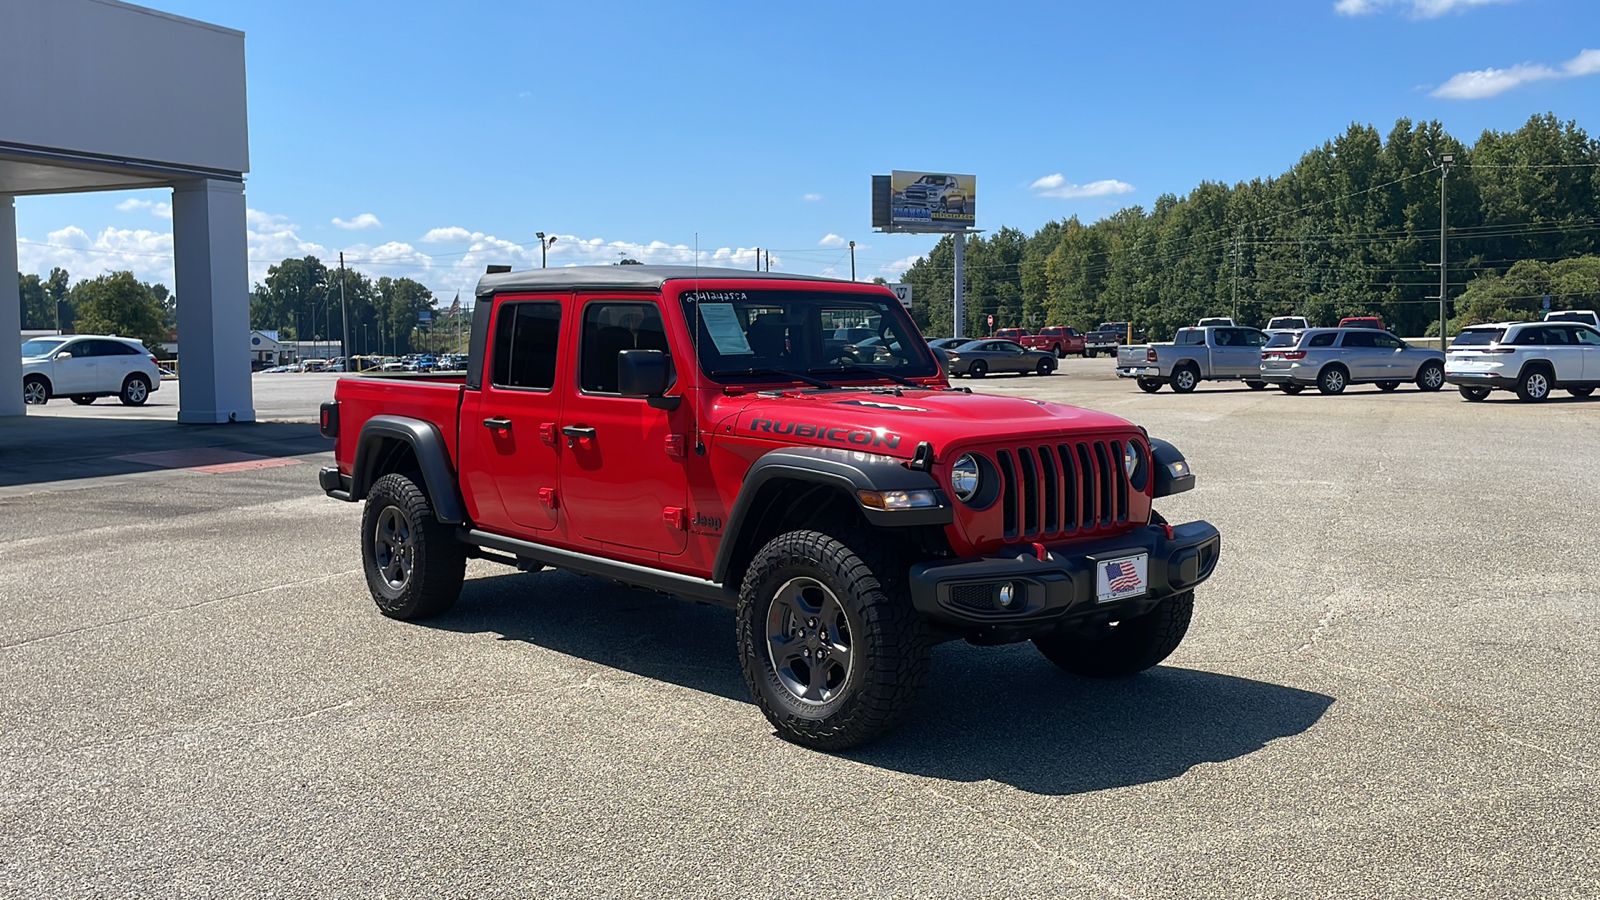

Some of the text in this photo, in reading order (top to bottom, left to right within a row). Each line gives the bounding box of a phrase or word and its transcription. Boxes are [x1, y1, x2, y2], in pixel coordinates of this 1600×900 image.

[893, 208, 931, 218] THOMSON
[751, 418, 901, 449] RUBICON
[691, 511, 722, 531] Jeep
